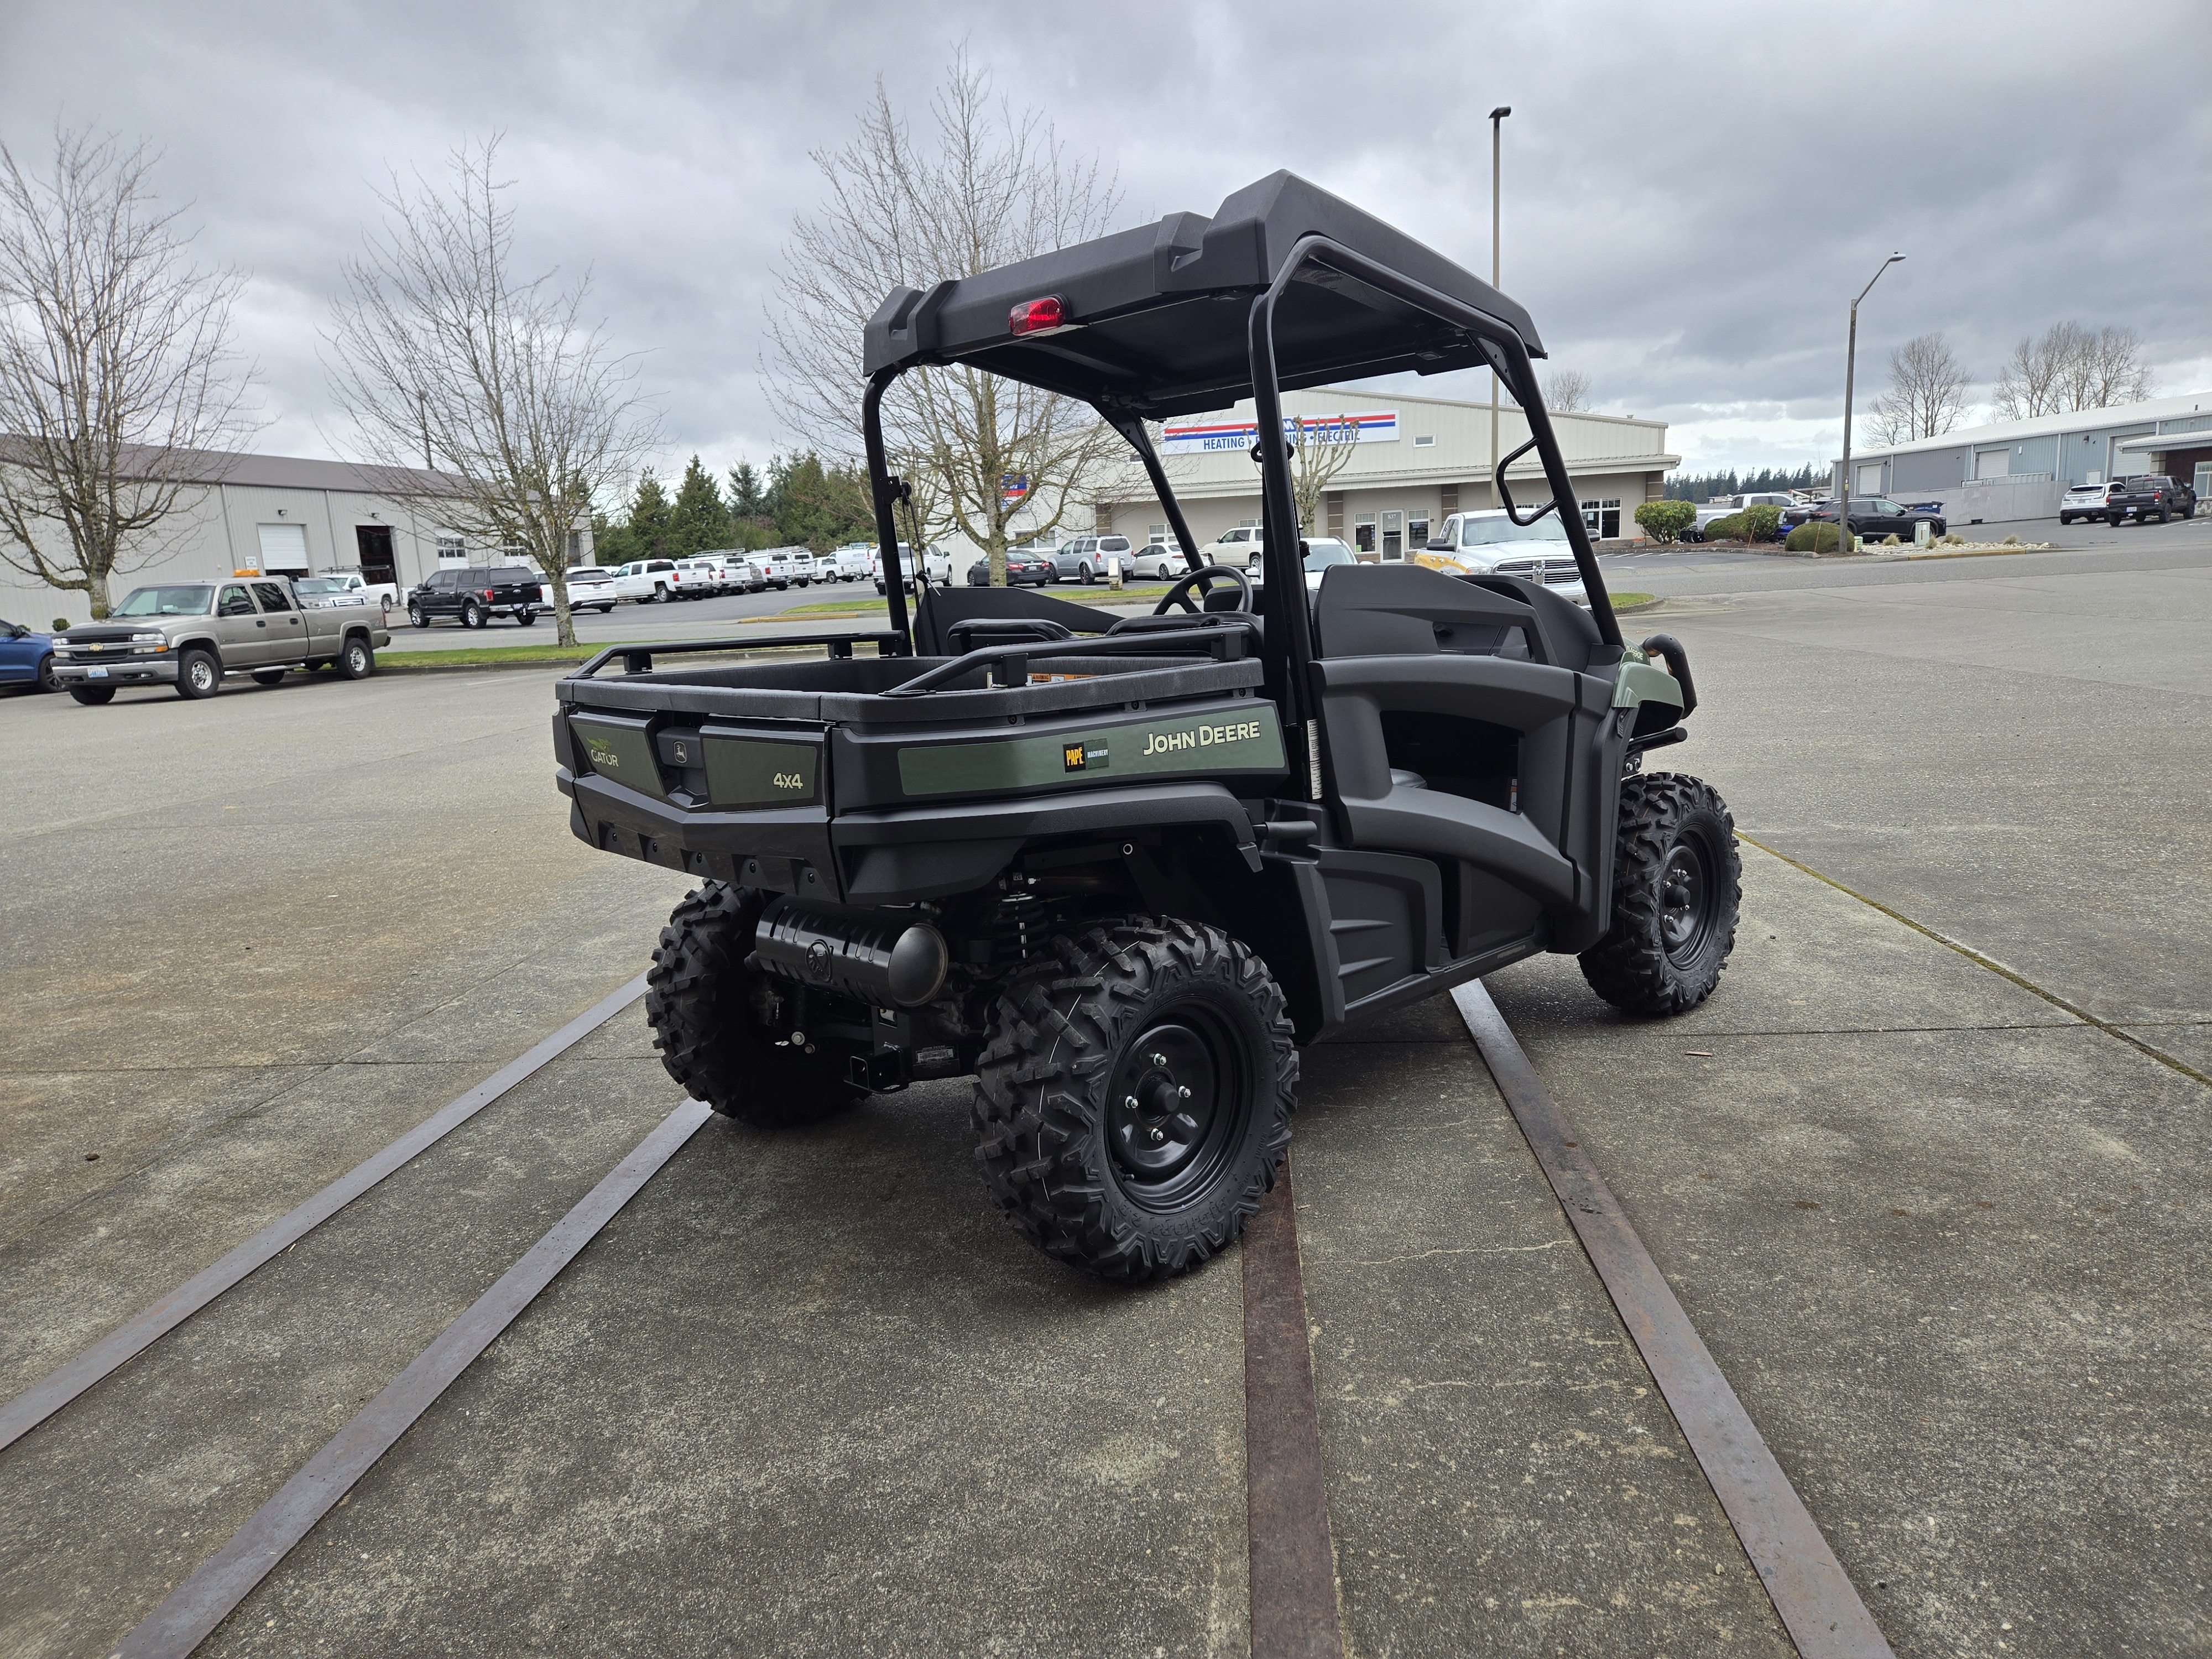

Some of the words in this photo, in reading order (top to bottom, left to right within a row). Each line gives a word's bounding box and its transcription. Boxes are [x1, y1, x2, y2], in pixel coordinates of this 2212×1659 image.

[1203, 437, 1245, 450] HEATING
[1143, 731, 1196, 756] JOHN
[1199, 721, 1261, 747] DEERE
[591, 749, 619, 767] GATOR
